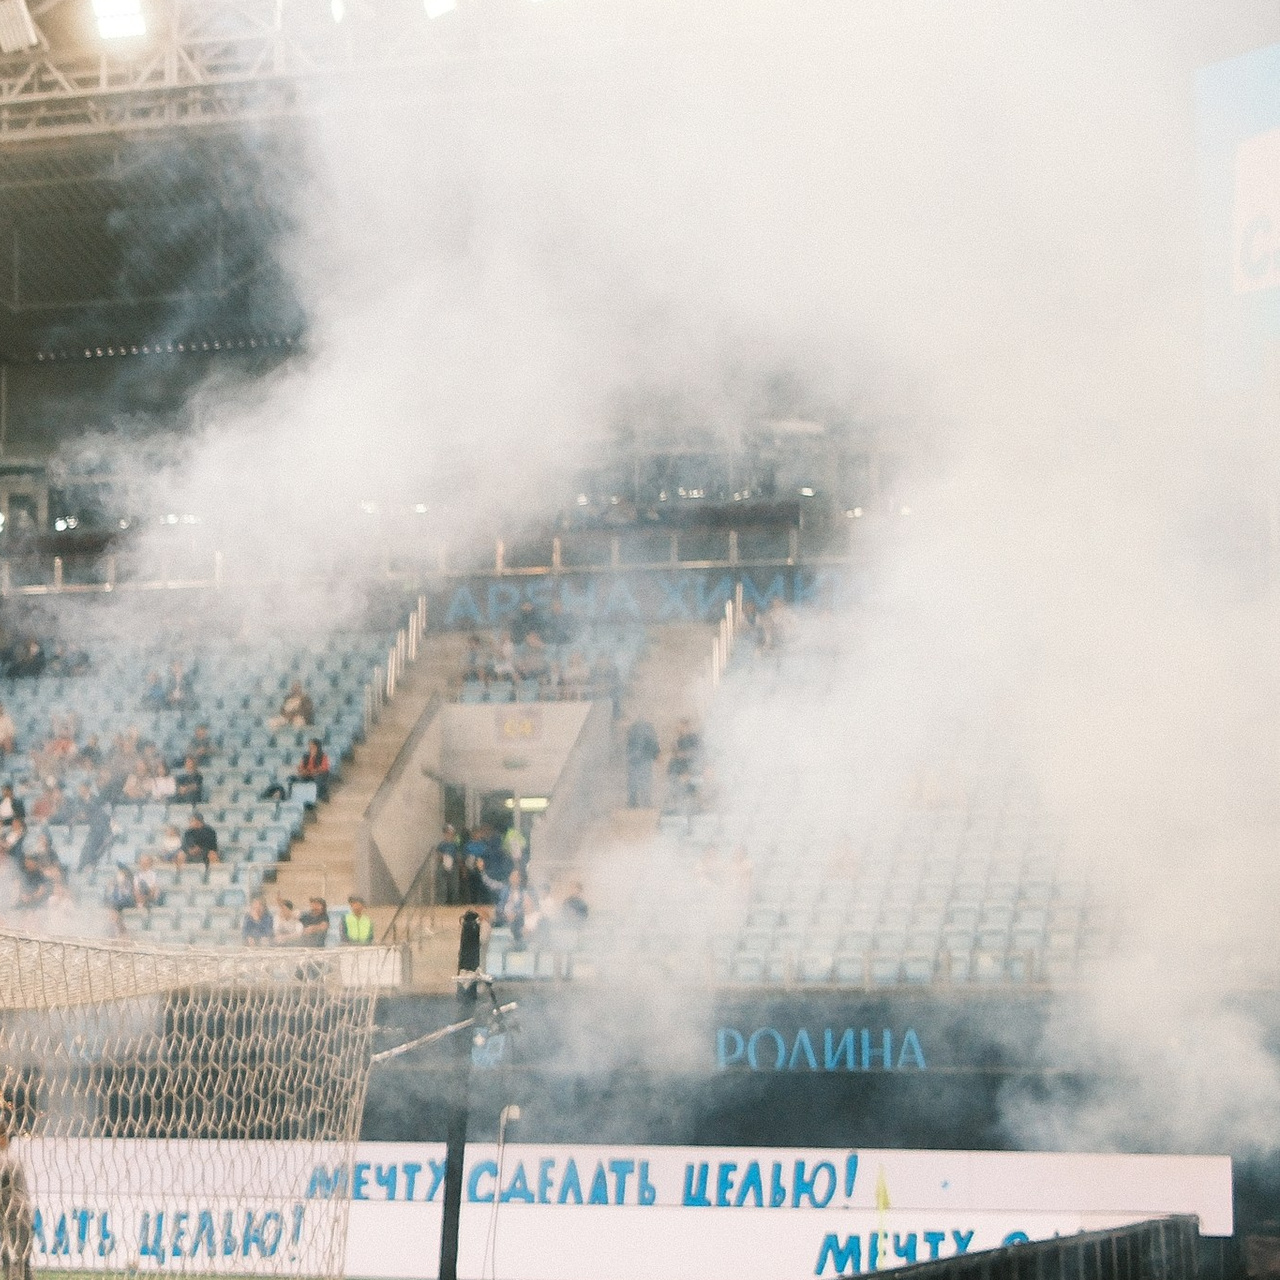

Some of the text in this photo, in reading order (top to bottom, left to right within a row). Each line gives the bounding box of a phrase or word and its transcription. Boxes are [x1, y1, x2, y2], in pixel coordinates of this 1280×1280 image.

[304, 1153, 859, 1208] МЕЧТУ СДЕЛАТЬ ЦЕЛЬЮ!
[139, 1204, 304, 1264] ЦЕЛЬЮ!
